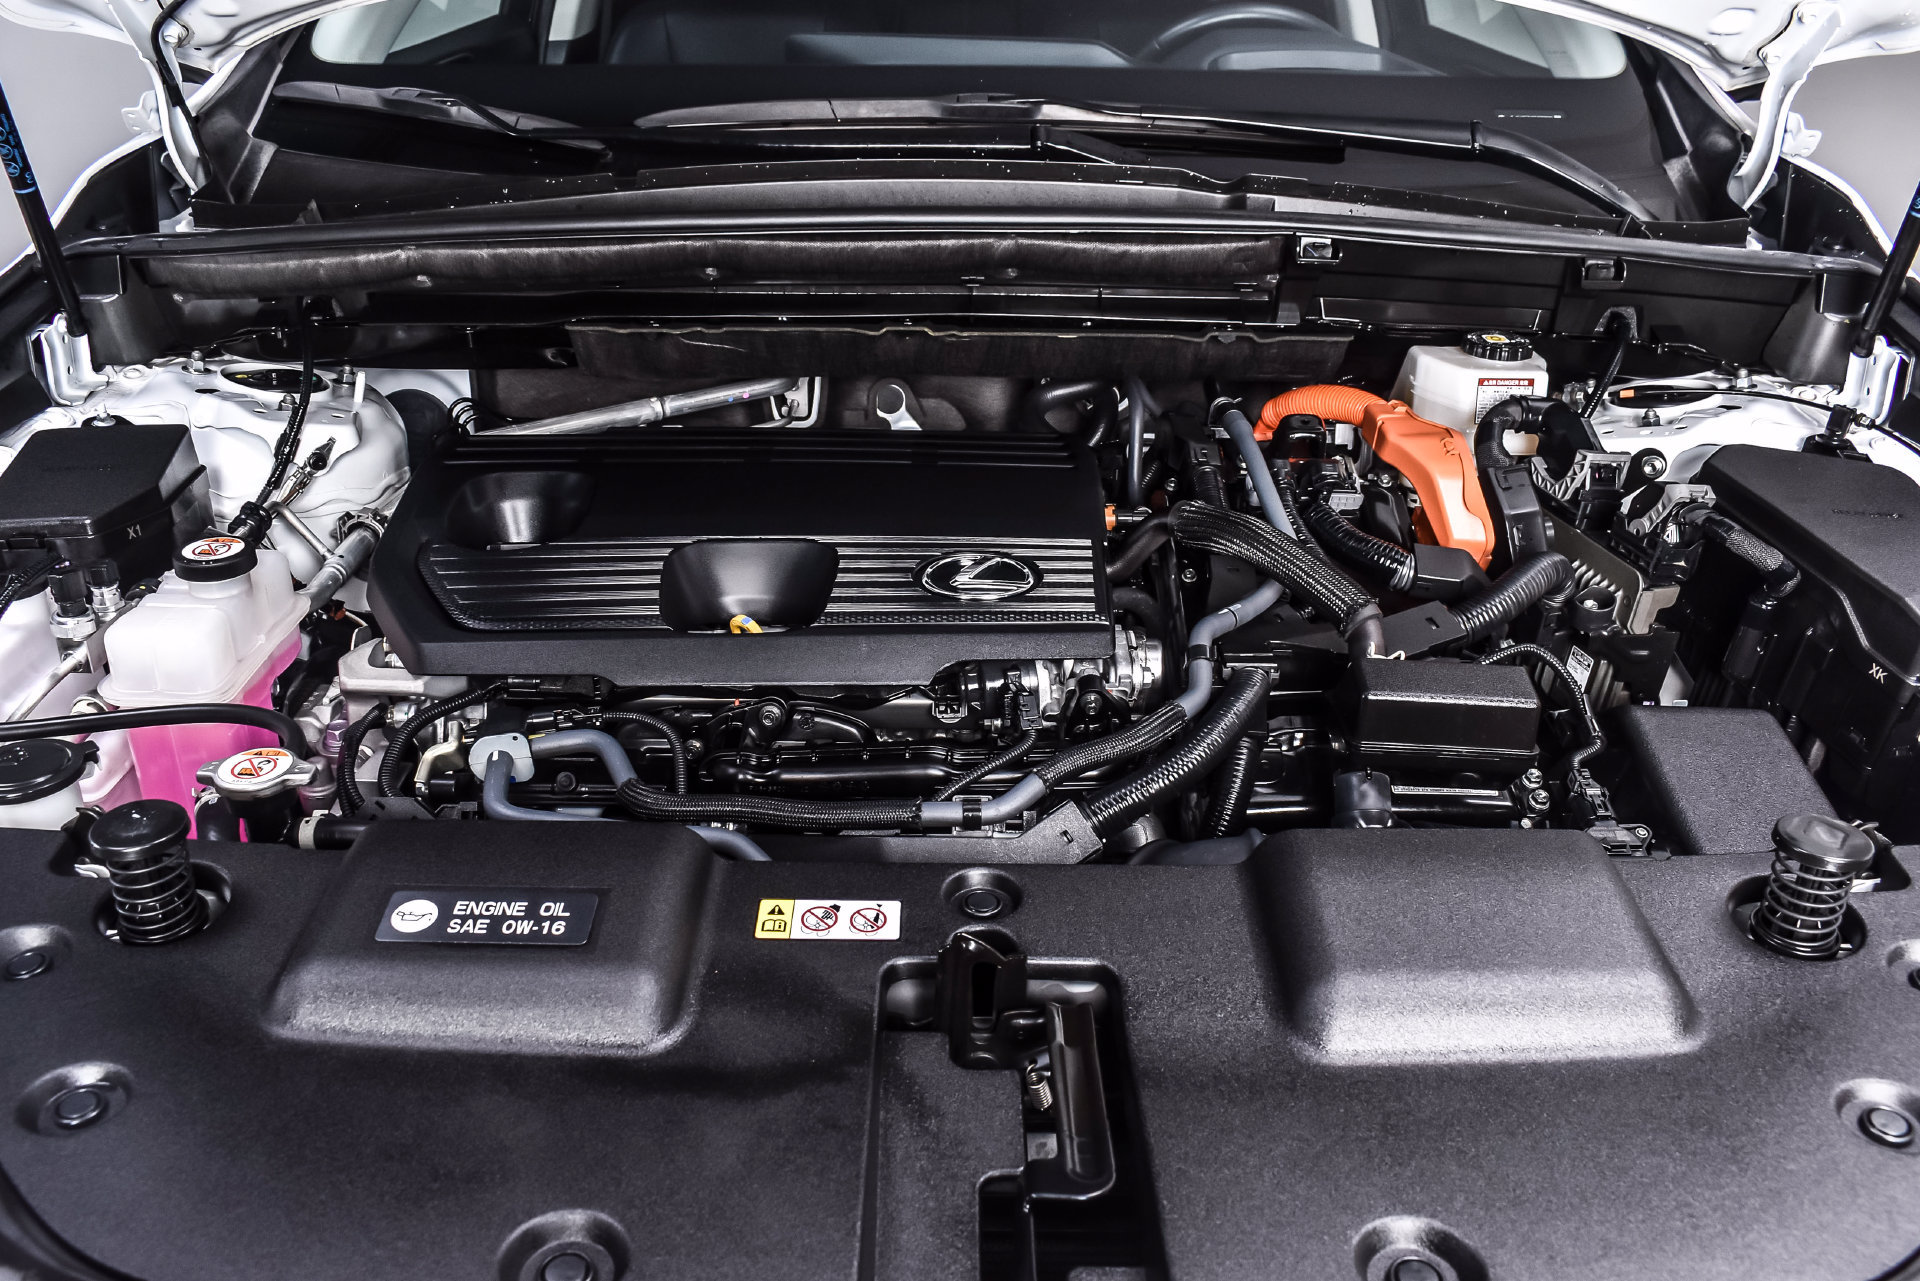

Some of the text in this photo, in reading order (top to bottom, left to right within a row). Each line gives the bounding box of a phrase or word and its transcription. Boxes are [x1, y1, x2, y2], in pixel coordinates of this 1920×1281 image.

[127, 524, 141, 540] X1
[1868, 662, 1888, 685] XK
[452, 900, 571, 917] ENGINE OIL
[446, 918, 567, 936] SAE 0W-16
